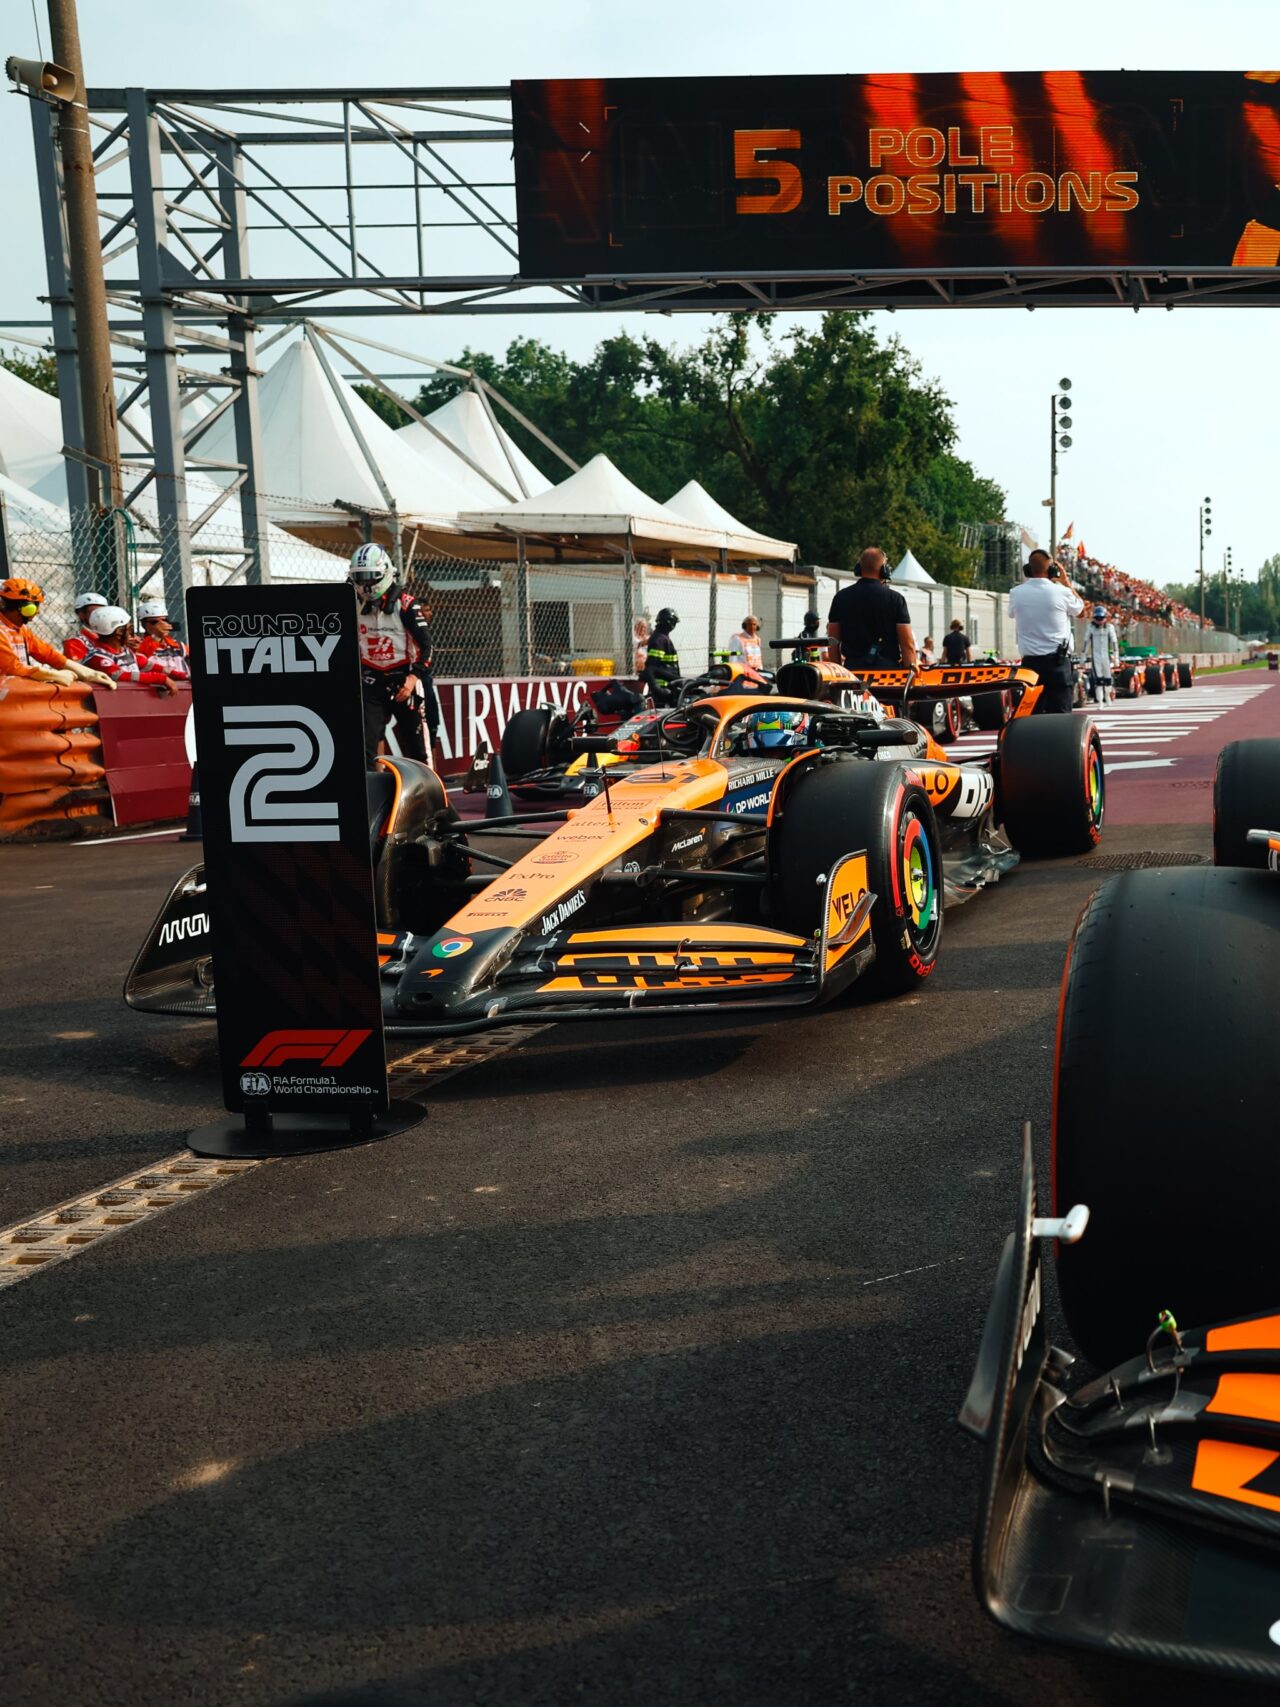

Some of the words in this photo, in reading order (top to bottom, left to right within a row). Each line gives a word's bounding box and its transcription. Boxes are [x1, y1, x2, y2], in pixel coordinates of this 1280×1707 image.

[868, 126, 1014, 168] POLE
[733, 129, 801, 214] 5
[828, 171, 1140, 215] POSITIONS
[202, 613, 304, 637] ROUND
[306, 612, 342, 635] 16
[204, 634, 342, 675] ITALY
[222, 704, 341, 843] 2
[728, 774, 756, 791] RICHARD
[755, 768, 775, 783] MILLE
[735, 799, 747, 814] DP
[671, 834, 703, 852] McLaren
[541, 908, 560, 936] JACK
[557, 888, 587, 920] DANIEL'S
[239, 1029, 374, 1067] F1
[273, 1076, 289, 1085] FIA
[290, 1076, 330, 1085] Formula
[273, 1085, 302, 1094] World
[304, 1085, 372, 1095] Championship
